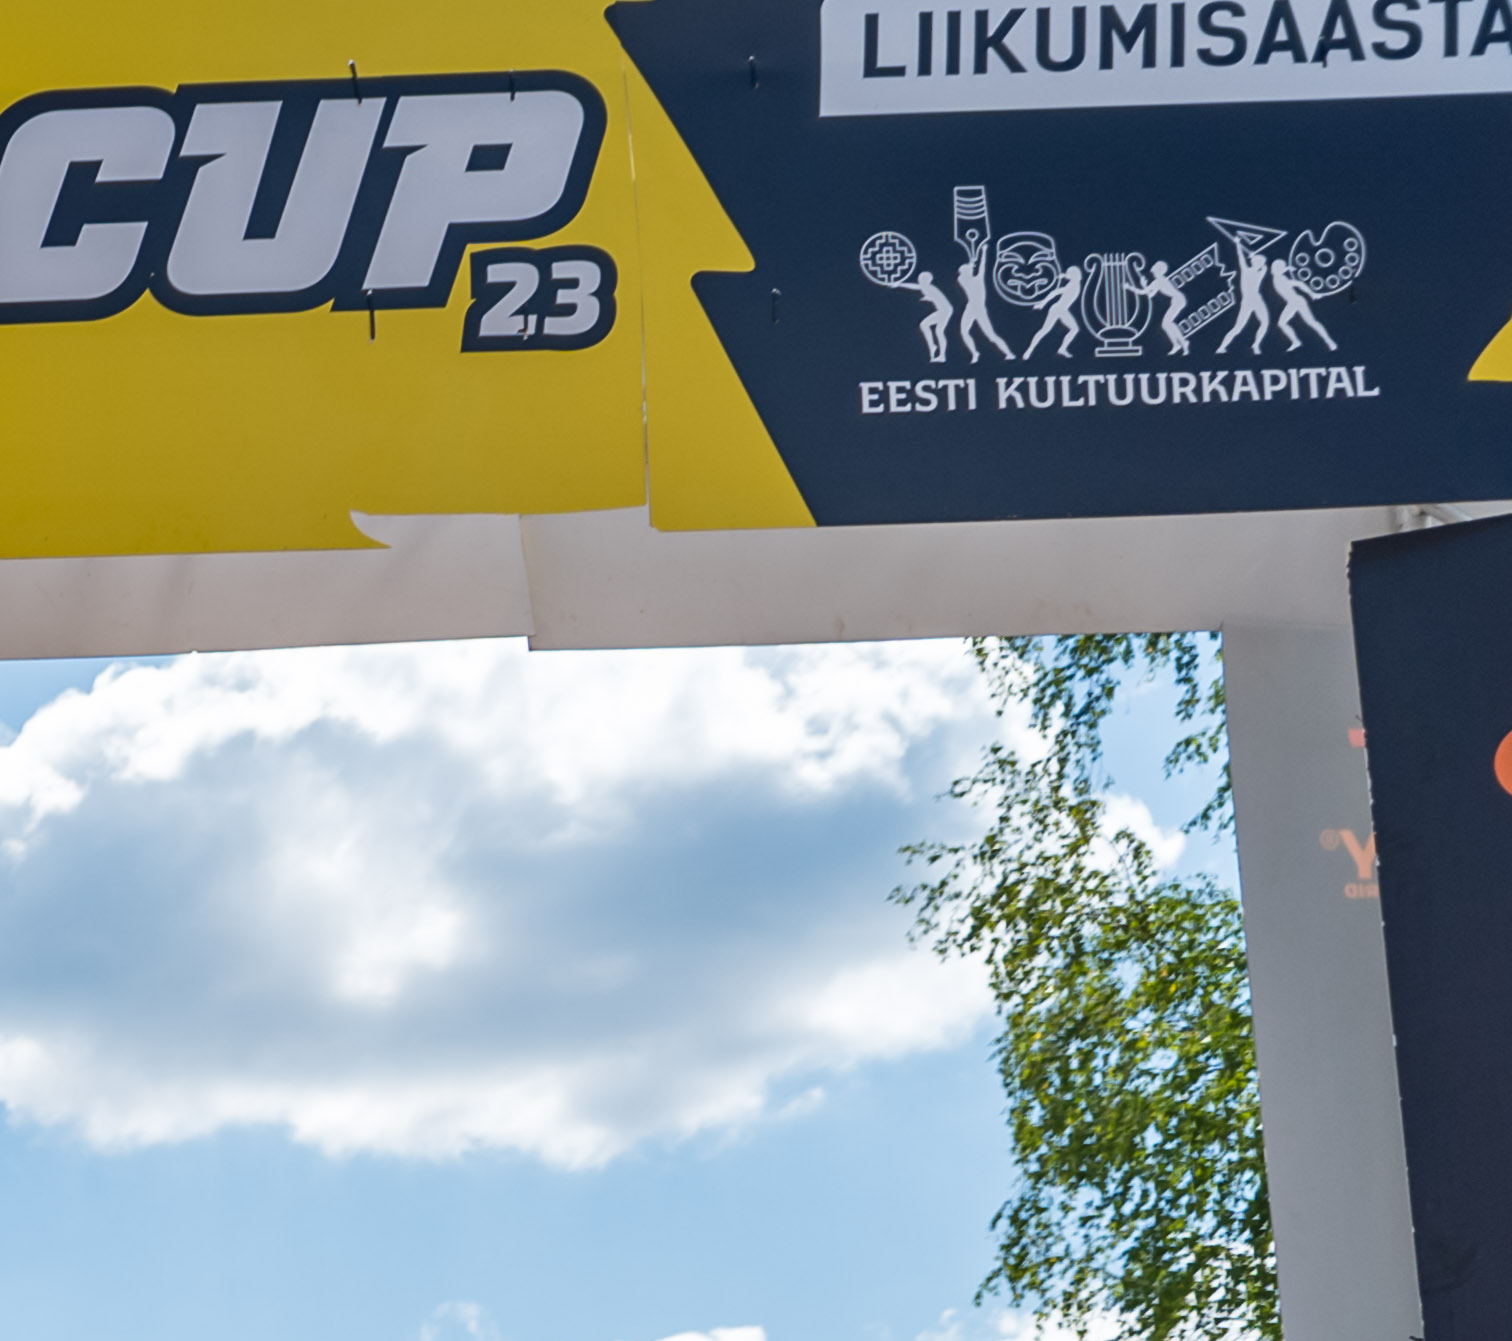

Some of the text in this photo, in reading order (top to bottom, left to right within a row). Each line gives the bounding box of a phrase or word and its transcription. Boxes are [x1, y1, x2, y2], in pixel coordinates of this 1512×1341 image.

[477, 263, 602, 339] 23
[860, 366, 1381, 415] EESTI KULTUURKAPITAL
